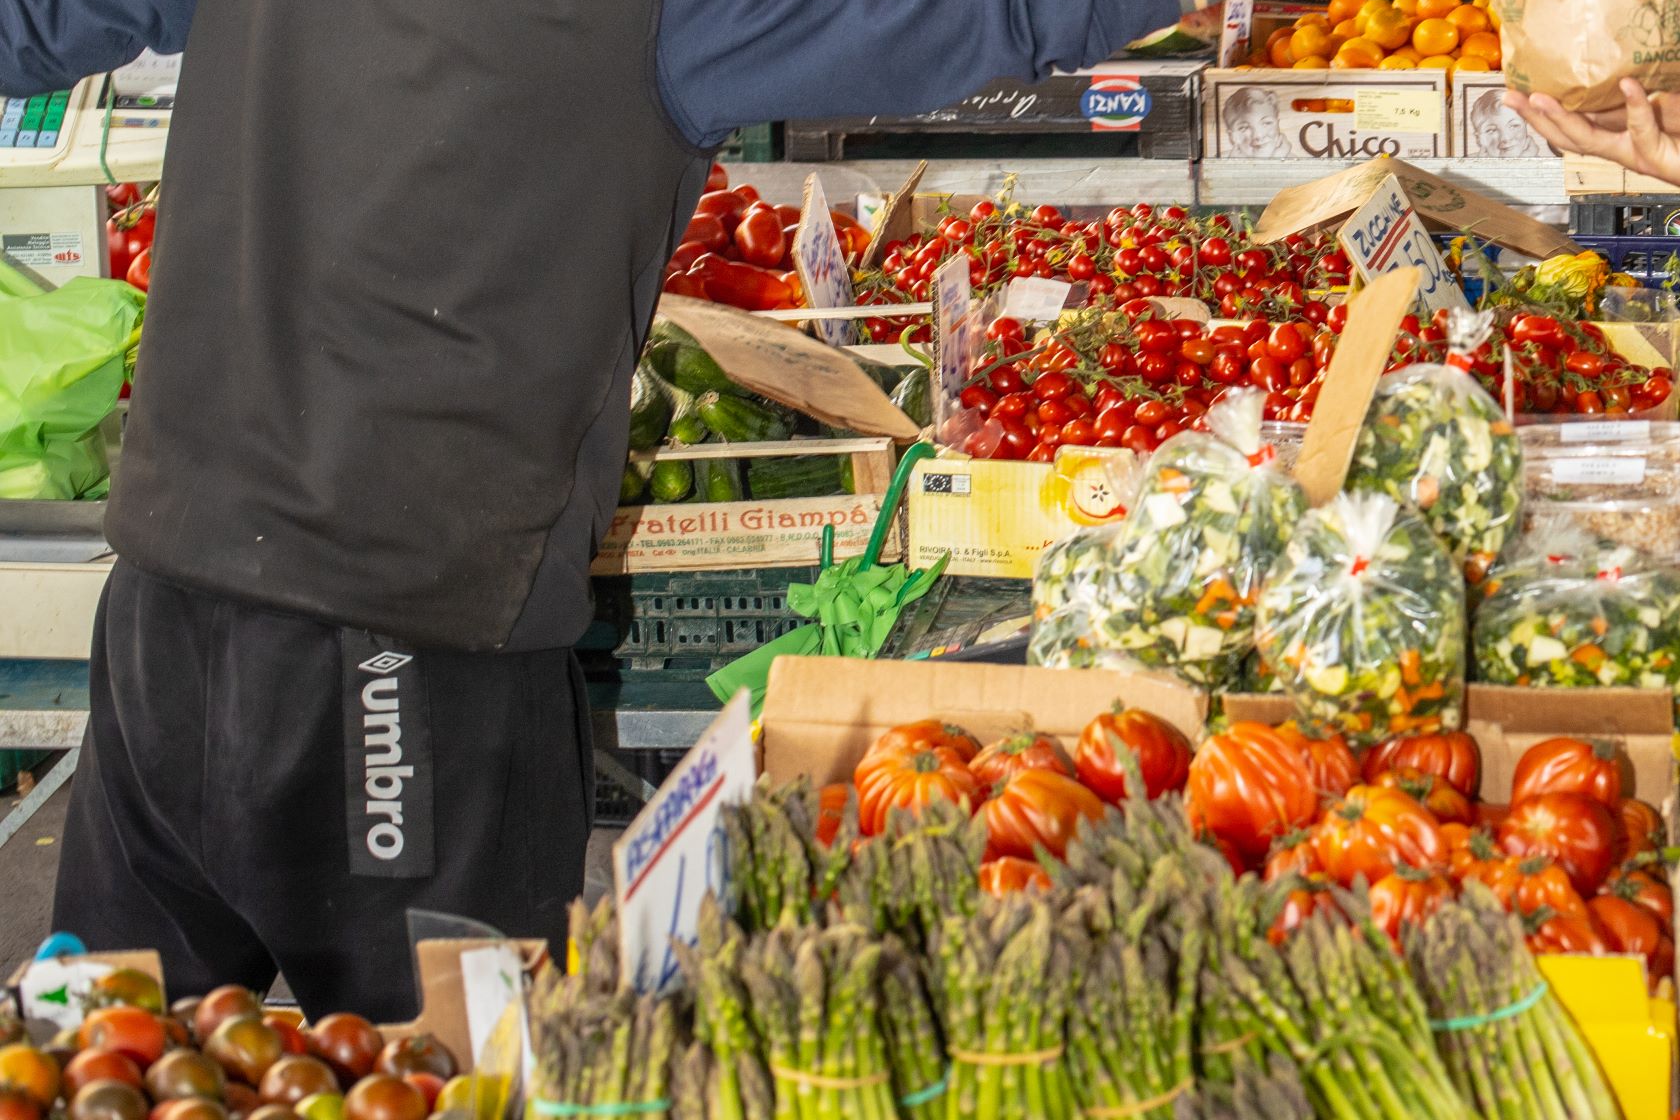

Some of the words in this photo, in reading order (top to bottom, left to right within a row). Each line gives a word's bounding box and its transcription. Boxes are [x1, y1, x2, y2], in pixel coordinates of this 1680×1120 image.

[1299, 120, 1401, 159] Chico
[608, 510, 729, 537] Fratelli
[964, 548, 970, 556] &
[361, 677, 414, 860] umbro
